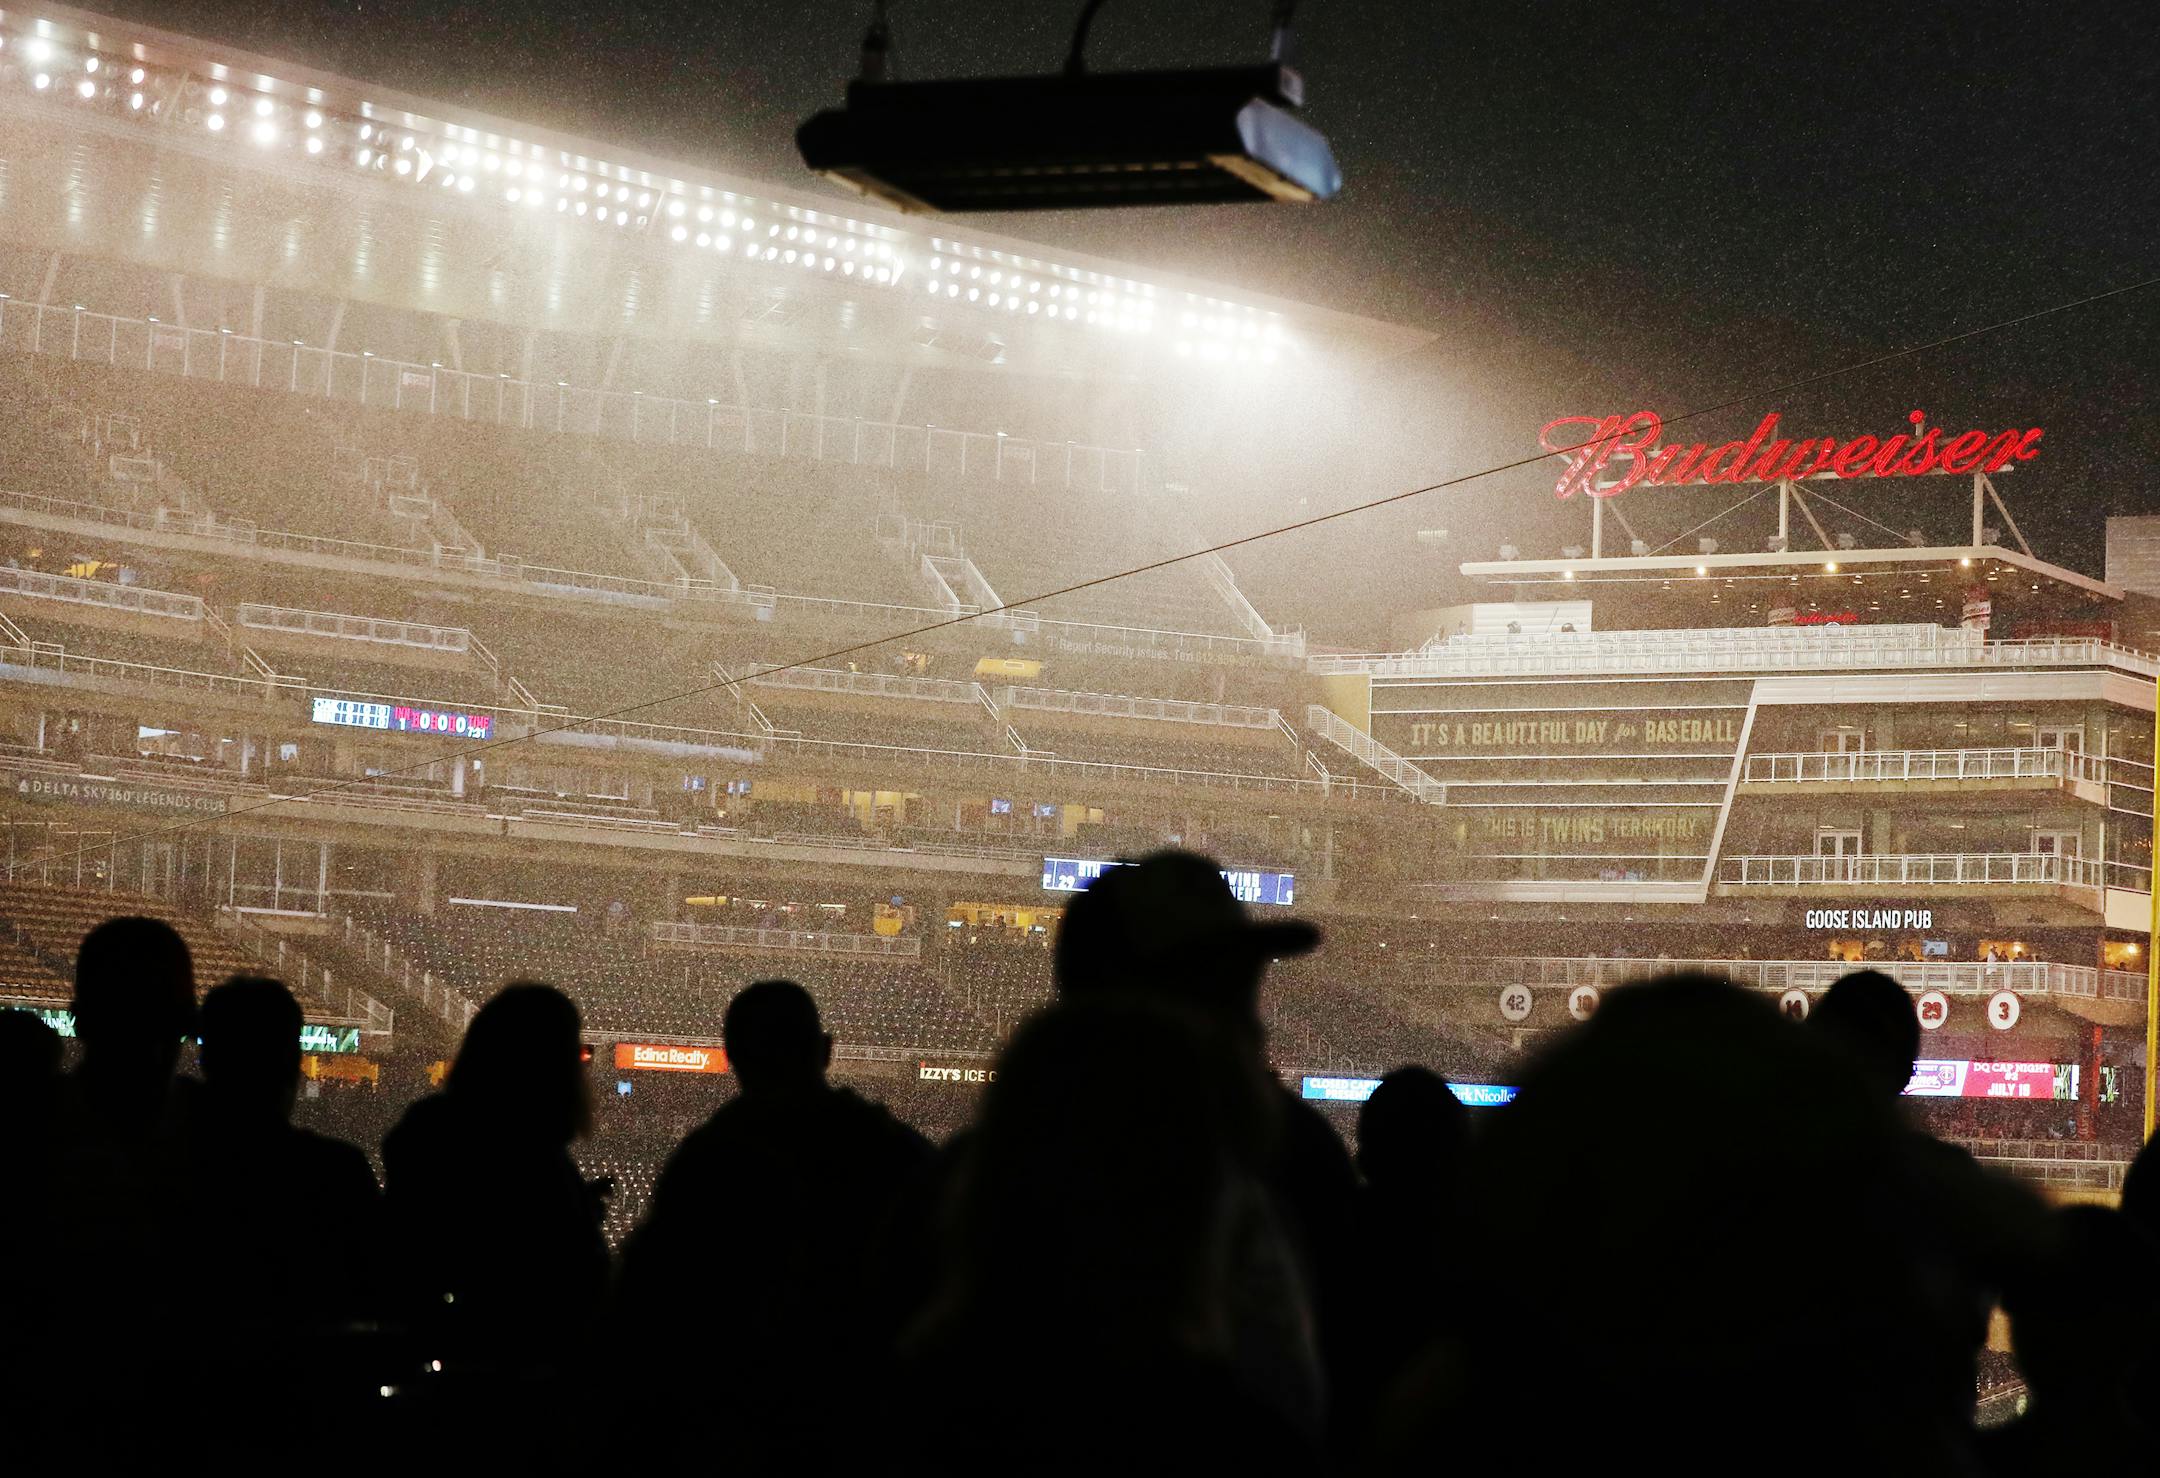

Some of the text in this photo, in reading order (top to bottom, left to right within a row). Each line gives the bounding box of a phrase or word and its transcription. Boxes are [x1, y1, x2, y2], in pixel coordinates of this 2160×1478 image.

[1538, 409, 2045, 499] Budweiser
[1060, 639, 1092, 654] Report
[1095, 643, 1134, 659] Security
[420, 712, 431, 729] 0
[438, 715, 449, 731] 0
[456, 717, 466, 733] 0
[468, 715, 489, 729] TIME
[1411, 723, 1448, 745] IT'S
[1455, 722, 1466, 745] A
[1472, 722, 1569, 745] BEAUTIFUL
[1576, 721, 1608, 744] DAY
[1645, 720, 1735, 743] BASEBALL
[33, 780, 226, 812] DELTA SKY360 LEGENDS CLUB
[1541, 816, 1605, 843] TWINS
[1611, 817, 1699, 838] TERRITORY
[1806, 910, 1932, 929] GOOSE ISLAND PUB
[1506, 994, 1525, 1011] 42
[1999, 1002, 2009, 1020] 3
[634, 1046, 668, 1062] Edina
[920, 1067, 961, 1081] IZZY'S
[964, 1069, 986, 1082] ICE
[1973, 1062, 1990, 1074] DQ
[2015, 1063, 2050, 1074] NIGHT
[1987, 1083, 2016, 1097] JULY
